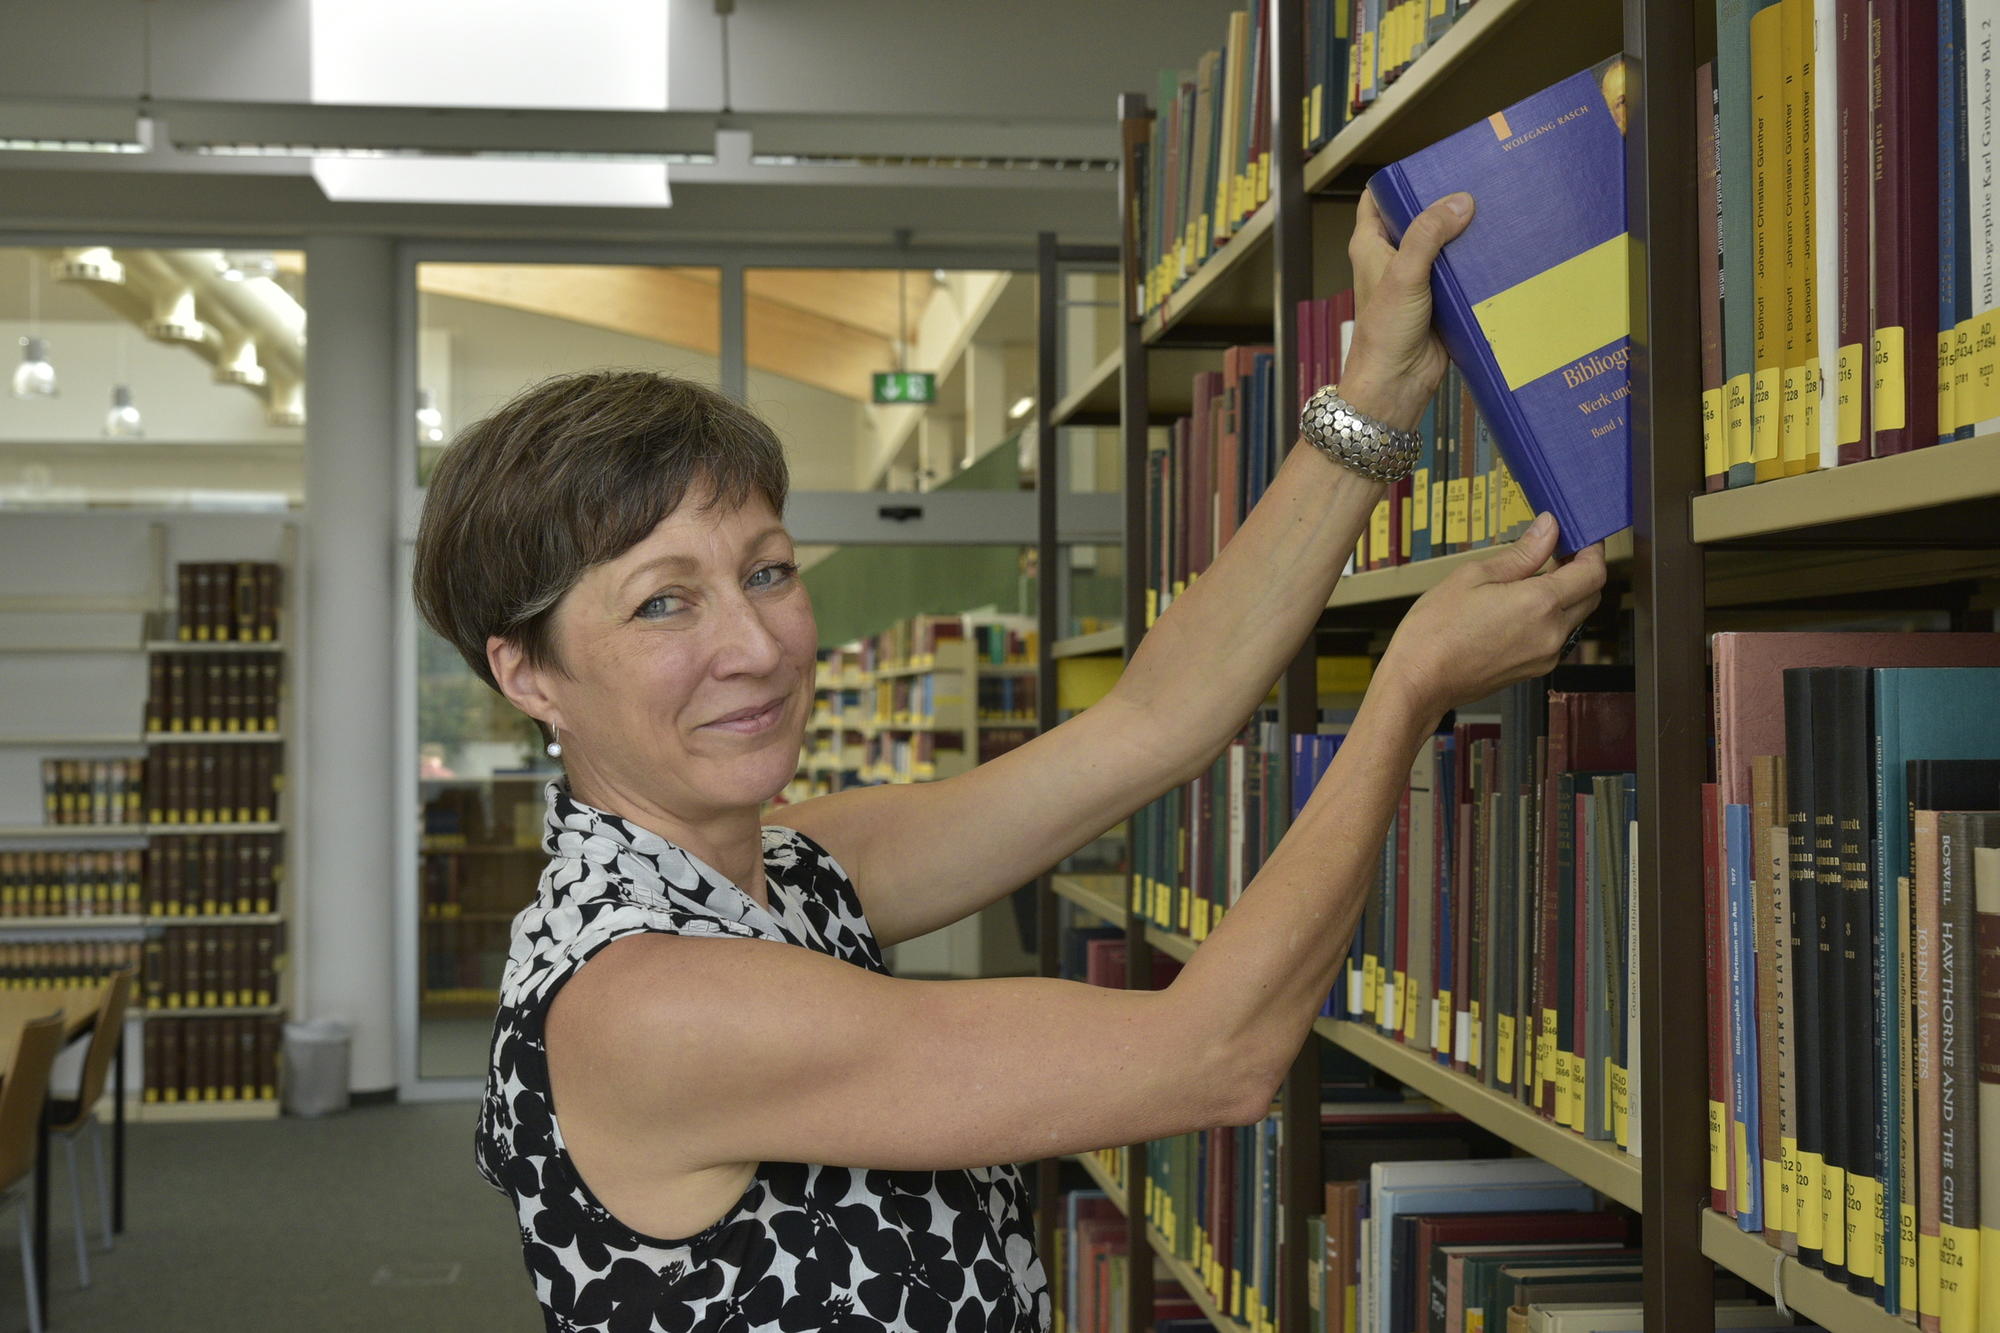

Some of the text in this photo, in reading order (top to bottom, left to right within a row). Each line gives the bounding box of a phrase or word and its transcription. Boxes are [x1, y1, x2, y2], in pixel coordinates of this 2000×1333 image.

[1872, 18, 1882, 59] Gundolf
[1785, 75, 1792, 84] II
[1873, 64, 1883, 109] Friedrich
[1502, 104, 1590, 152] WOLFGANG RASCH
[1756, 117, 1764, 168] Günther
[1981, 18, 1993, 305] Bibliographie Karl Gutzkow Bd. 2
[1756, 171, 1764, 228] Christian
[1841, 277, 1849, 335] Bibliography
[1786, 337, 1793, 351] R.
[1957, 332, 1967, 345] AD
[1980, 322, 1991, 336] AD
[1757, 345, 1764, 359] R.
[1578, 392, 1612, 416] Werk
[1591, 418, 1617, 439] Band
[1942, 835, 1951, 906] BOSWELL
[1630, 933, 1638, 976] Freytag
[1630, 978, 1639, 1019] Gustav
[1775, 938, 1785, 1058] JAROSLAVA
[1917, 925, 1929, 1080] JOHN HAWKES
[1942, 922, 1954, 1067] HAWTHORNE
[1943, 1076, 1954, 1122] AND
[1943, 1128, 1954, 1169] THE
[1942, 1237, 1956, 1251] AD
